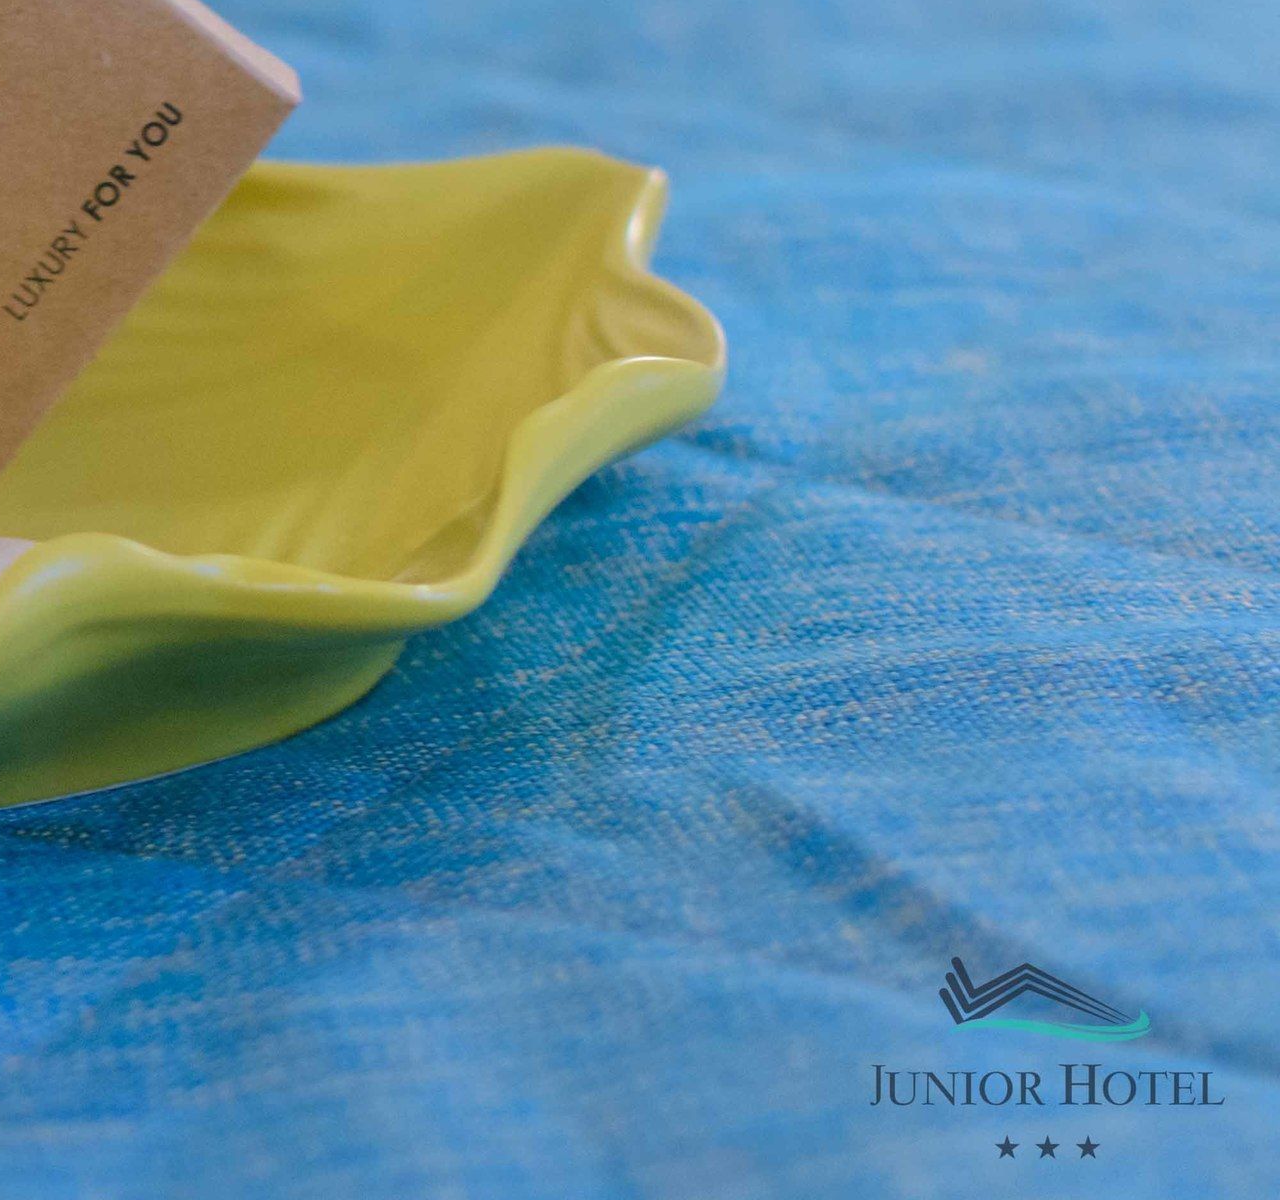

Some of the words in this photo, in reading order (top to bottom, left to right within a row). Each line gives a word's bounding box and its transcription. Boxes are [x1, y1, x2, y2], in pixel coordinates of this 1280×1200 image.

[1, 220, 89, 321] LUXURY
[80, 164, 137, 222] FOR
[124, 102, 183, 163] YOU
